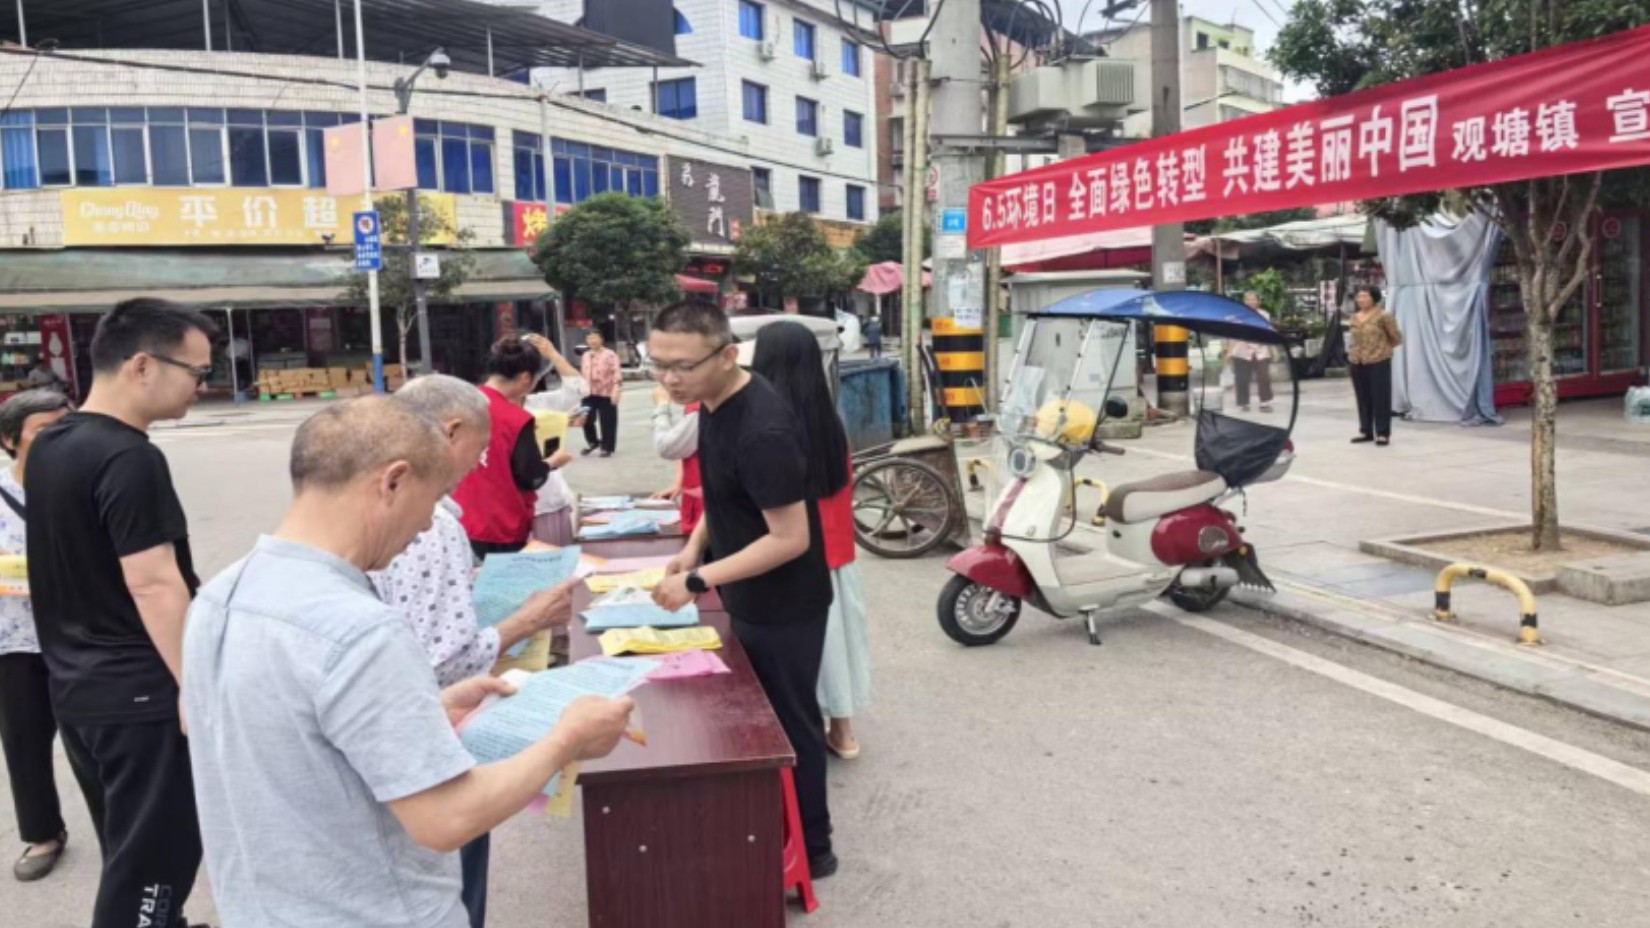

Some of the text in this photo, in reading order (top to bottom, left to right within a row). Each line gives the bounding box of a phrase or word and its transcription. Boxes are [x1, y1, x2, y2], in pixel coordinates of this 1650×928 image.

[982, 182, 1057, 231] 6.5环境日
[1068, 144, 1208, 221] 全面绿色转型
[1222, 94, 1438, 198] 共建美丽中国
[1452, 100, 1579, 163] 观塘镇
[1606, 87, 1650, 144] 宣
